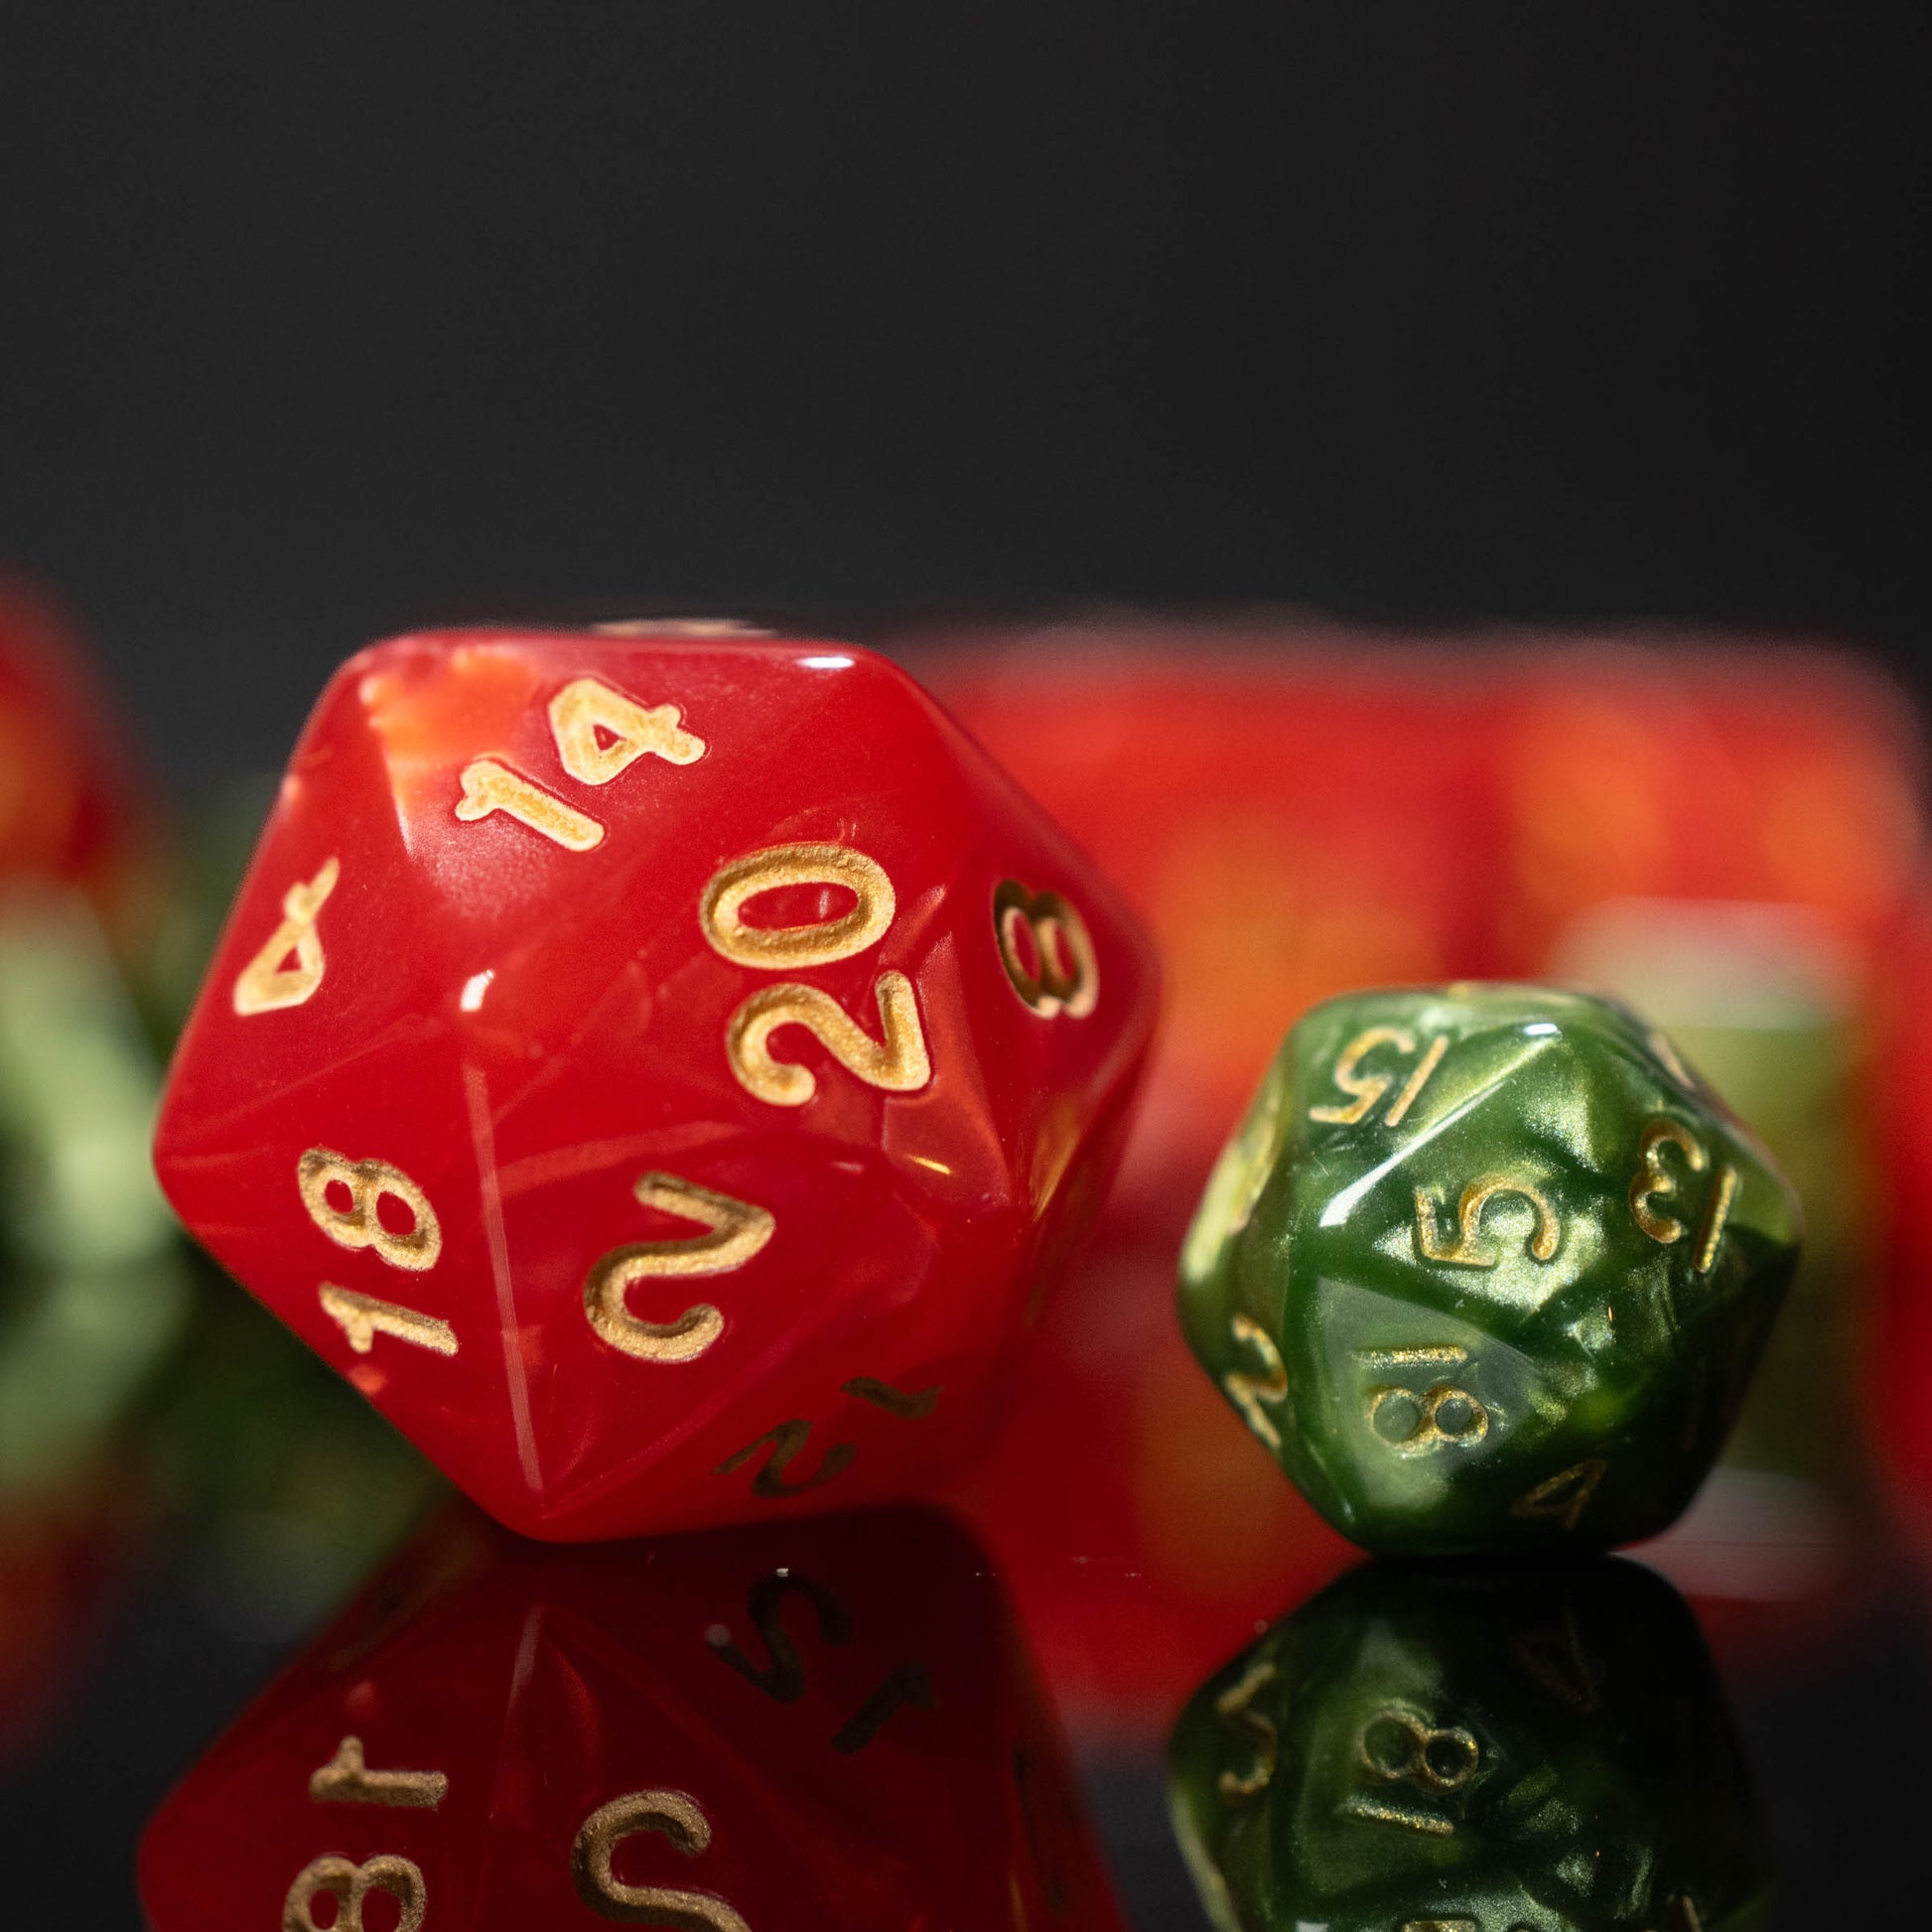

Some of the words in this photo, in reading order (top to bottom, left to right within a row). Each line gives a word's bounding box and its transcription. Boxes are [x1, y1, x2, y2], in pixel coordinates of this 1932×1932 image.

[455, 678, 707, 852] 14
[233, 857, 340, 1017] 4
[699, 842, 931, 1107] 20
[994, 880, 1099, 1019] 8
[1310, 1027, 1450, 1128] 15
[297, 1147, 460, 1357] 18
[583, 1171, 776, 1364] 2
[1414, 1176, 1561, 1267] 5
[1629, 1120, 1737, 1274] 13
[711, 1376, 948, 1499] 12
[1352, 1345, 1489, 1457] 18
